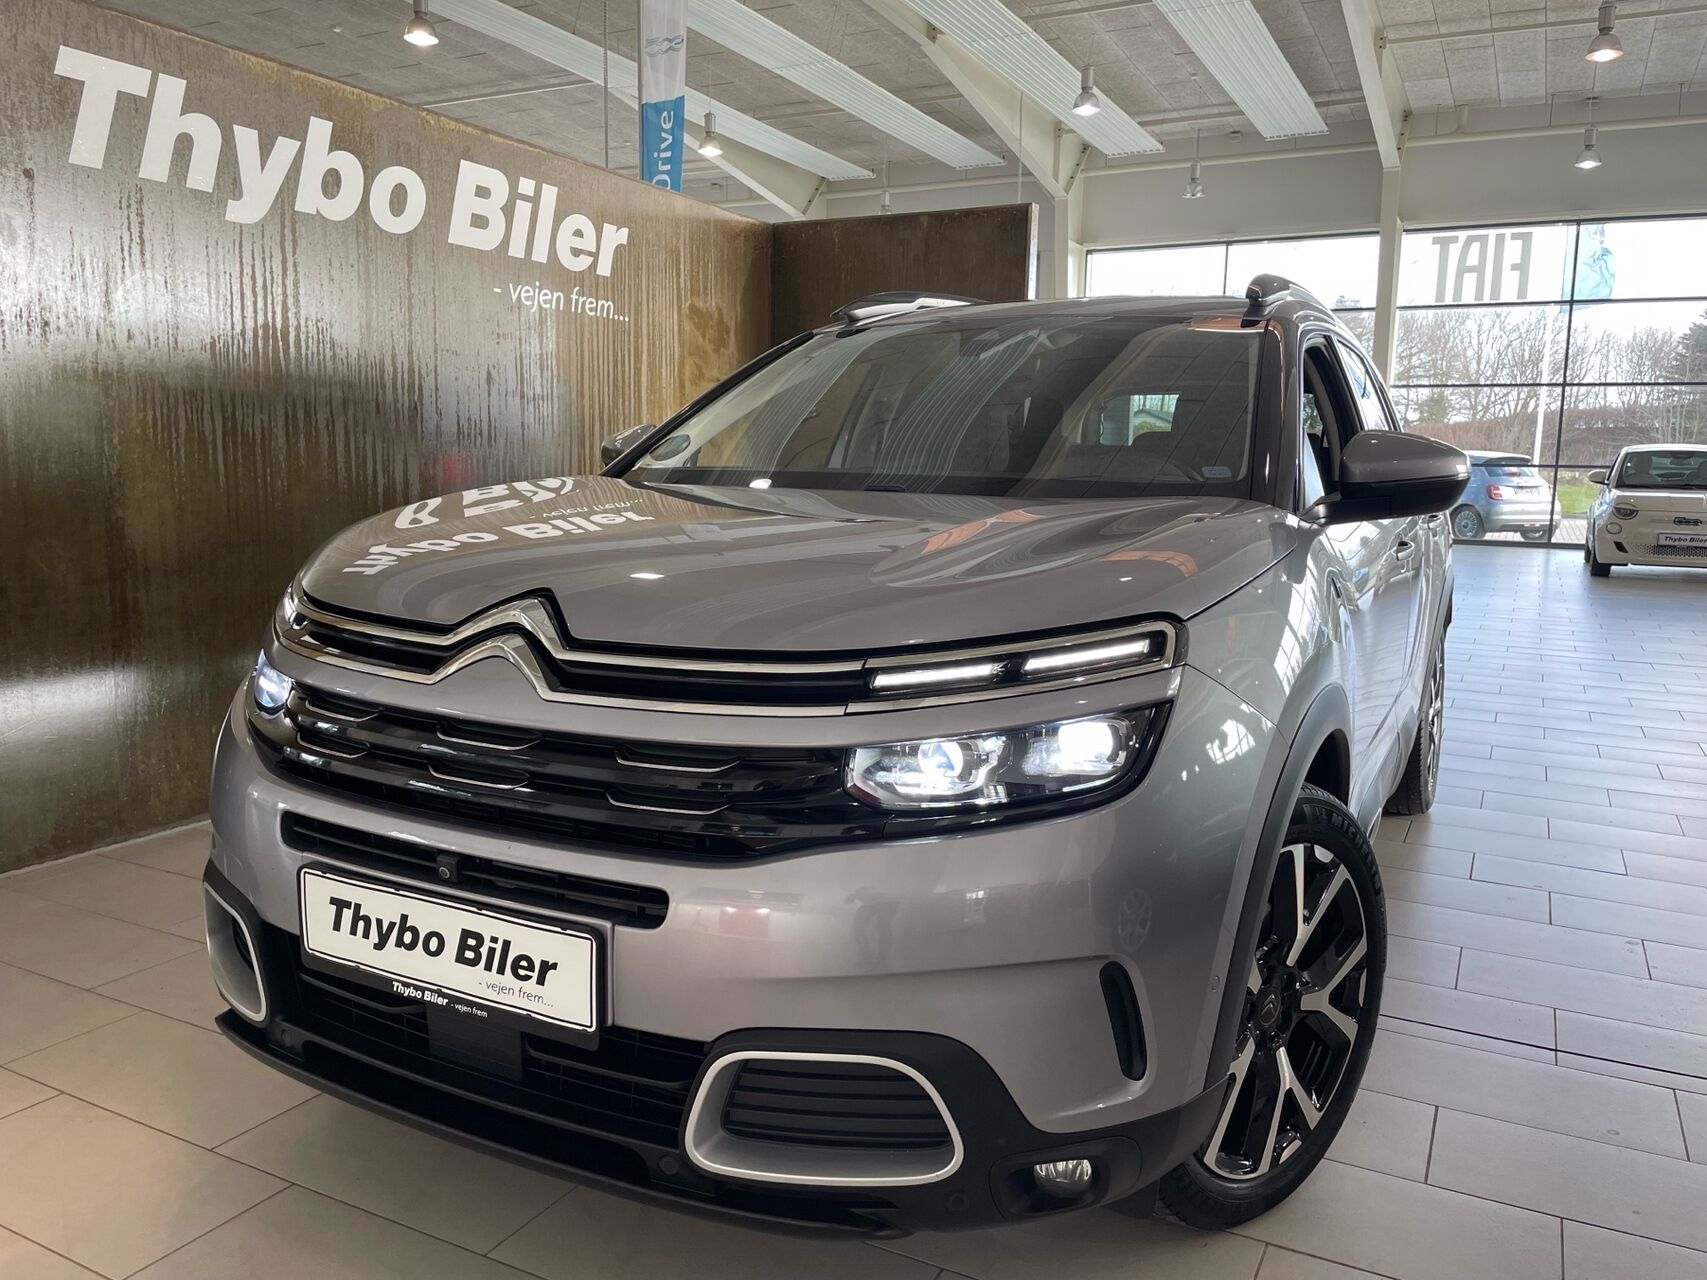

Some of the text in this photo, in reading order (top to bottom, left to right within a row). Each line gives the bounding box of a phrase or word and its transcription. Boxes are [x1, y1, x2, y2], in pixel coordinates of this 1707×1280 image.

[54, 45, 629, 278] Thybo Biler
[509, 281, 564, 312] vejen
[570, 286, 629, 321] frem...
[1664, 535, 1688, 543] Thybo
[329, 896, 558, 987] Thybo Biler
[392, 981, 422, 998] Thybo
[424, 990, 449, 1006] Biler
[454, 1003, 472, 1013] vejen
[472, 1006, 488, 1018] frem
[486, 980, 515, 997] vejen
[518, 987, 554, 1008] frem...
